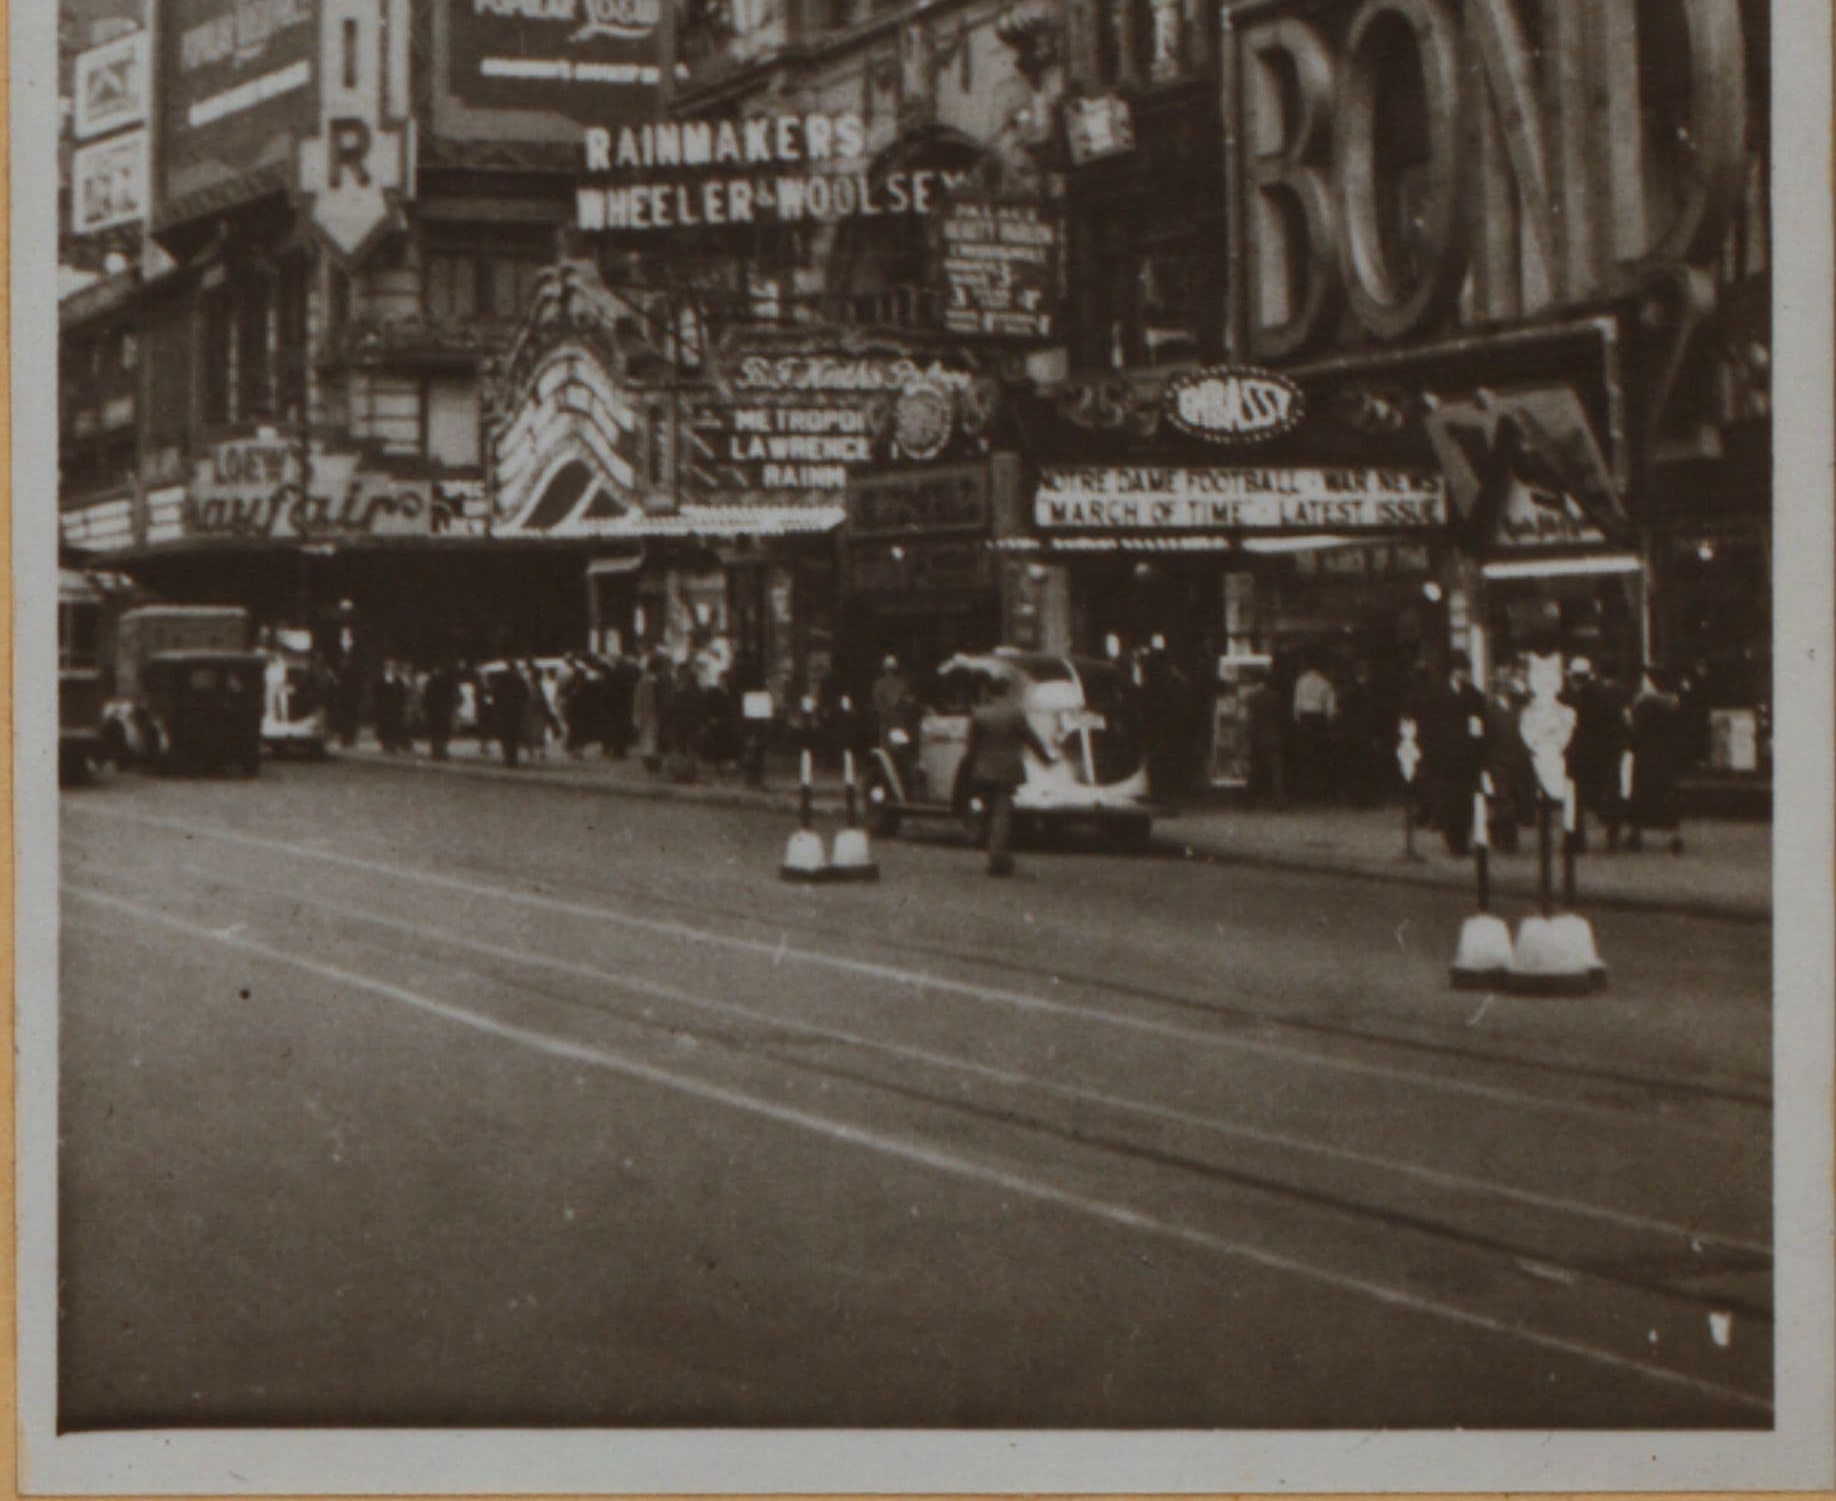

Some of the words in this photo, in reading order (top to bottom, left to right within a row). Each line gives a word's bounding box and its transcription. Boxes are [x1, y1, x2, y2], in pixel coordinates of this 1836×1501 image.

[584, 113, 865, 171] RAINMAKERS
[576, 178, 754, 230] WHEELER
[1041, 469, 1106, 492] NOTRE
[1118, 470, 1176, 492] DAME
[1187, 470, 1301, 493] FOOTBALL
[1323, 470, 1367, 492] WAR
[1377, 470, 1441, 492] NEWS
[1152, 499, 1175, 524] OF
[1279, 499, 1363, 525] LATEST
[1376, 499, 1442, 525] ISSUE
